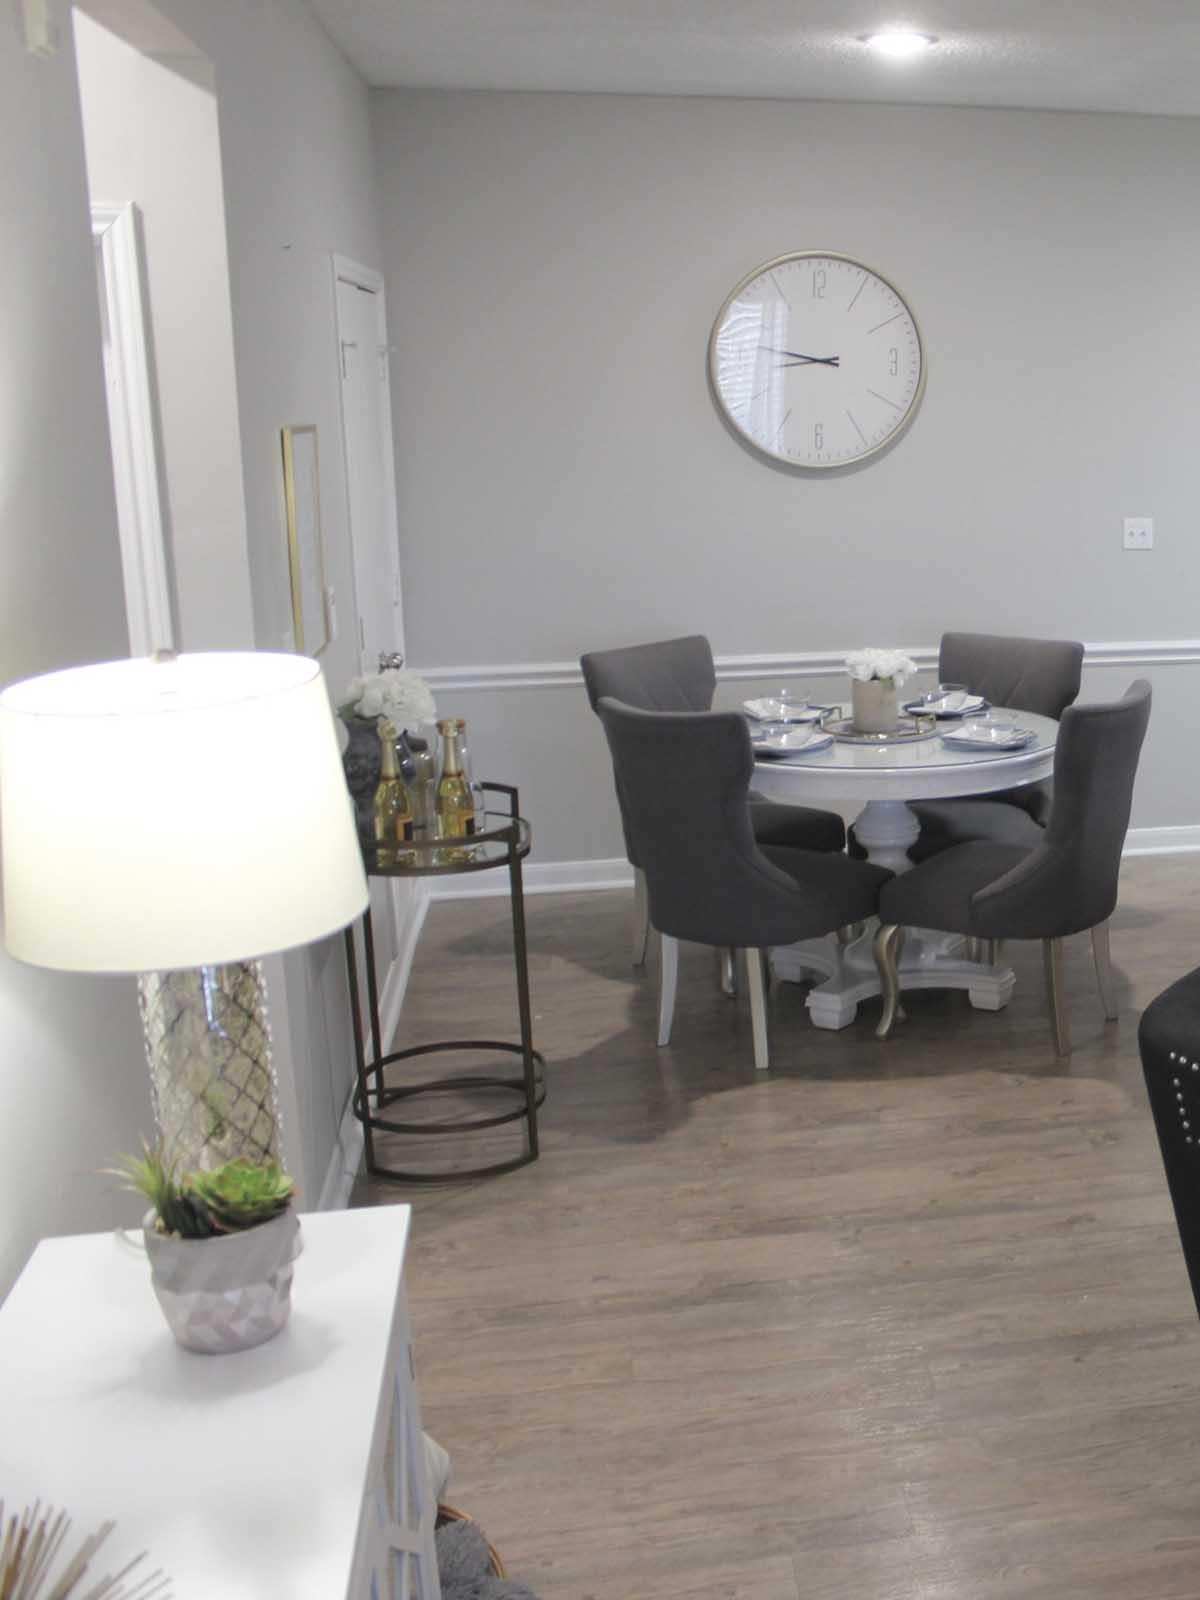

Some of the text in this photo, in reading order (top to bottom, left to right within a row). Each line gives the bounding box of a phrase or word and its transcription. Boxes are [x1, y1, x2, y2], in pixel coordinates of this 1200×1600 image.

[812, 269, 827, 299] 12
[889, 347, 899, 377] 3
[813, 423, 824, 450] 6
